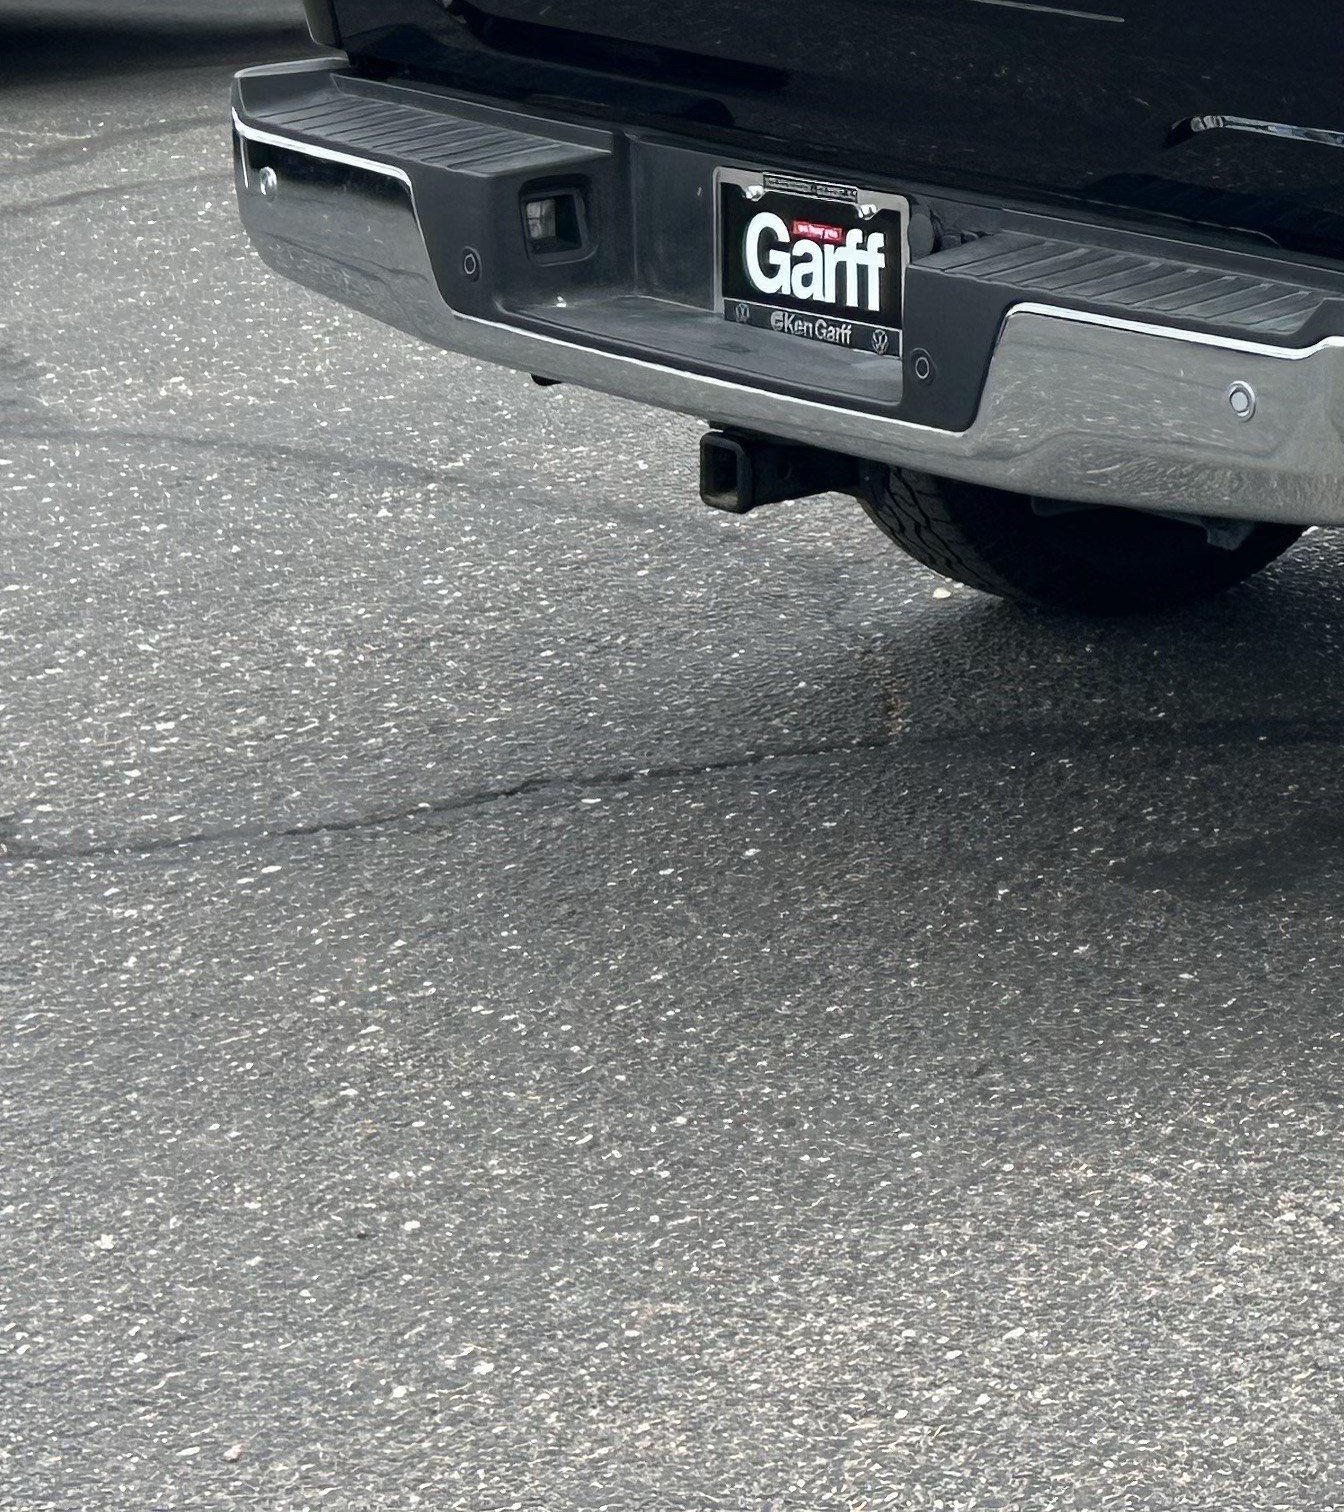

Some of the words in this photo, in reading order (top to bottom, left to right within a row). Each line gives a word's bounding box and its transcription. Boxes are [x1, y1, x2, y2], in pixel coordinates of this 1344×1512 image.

[745, 211, 886, 312] Garff
[784, 312, 813, 338] Ken
[814, 319, 852, 345] Garff
